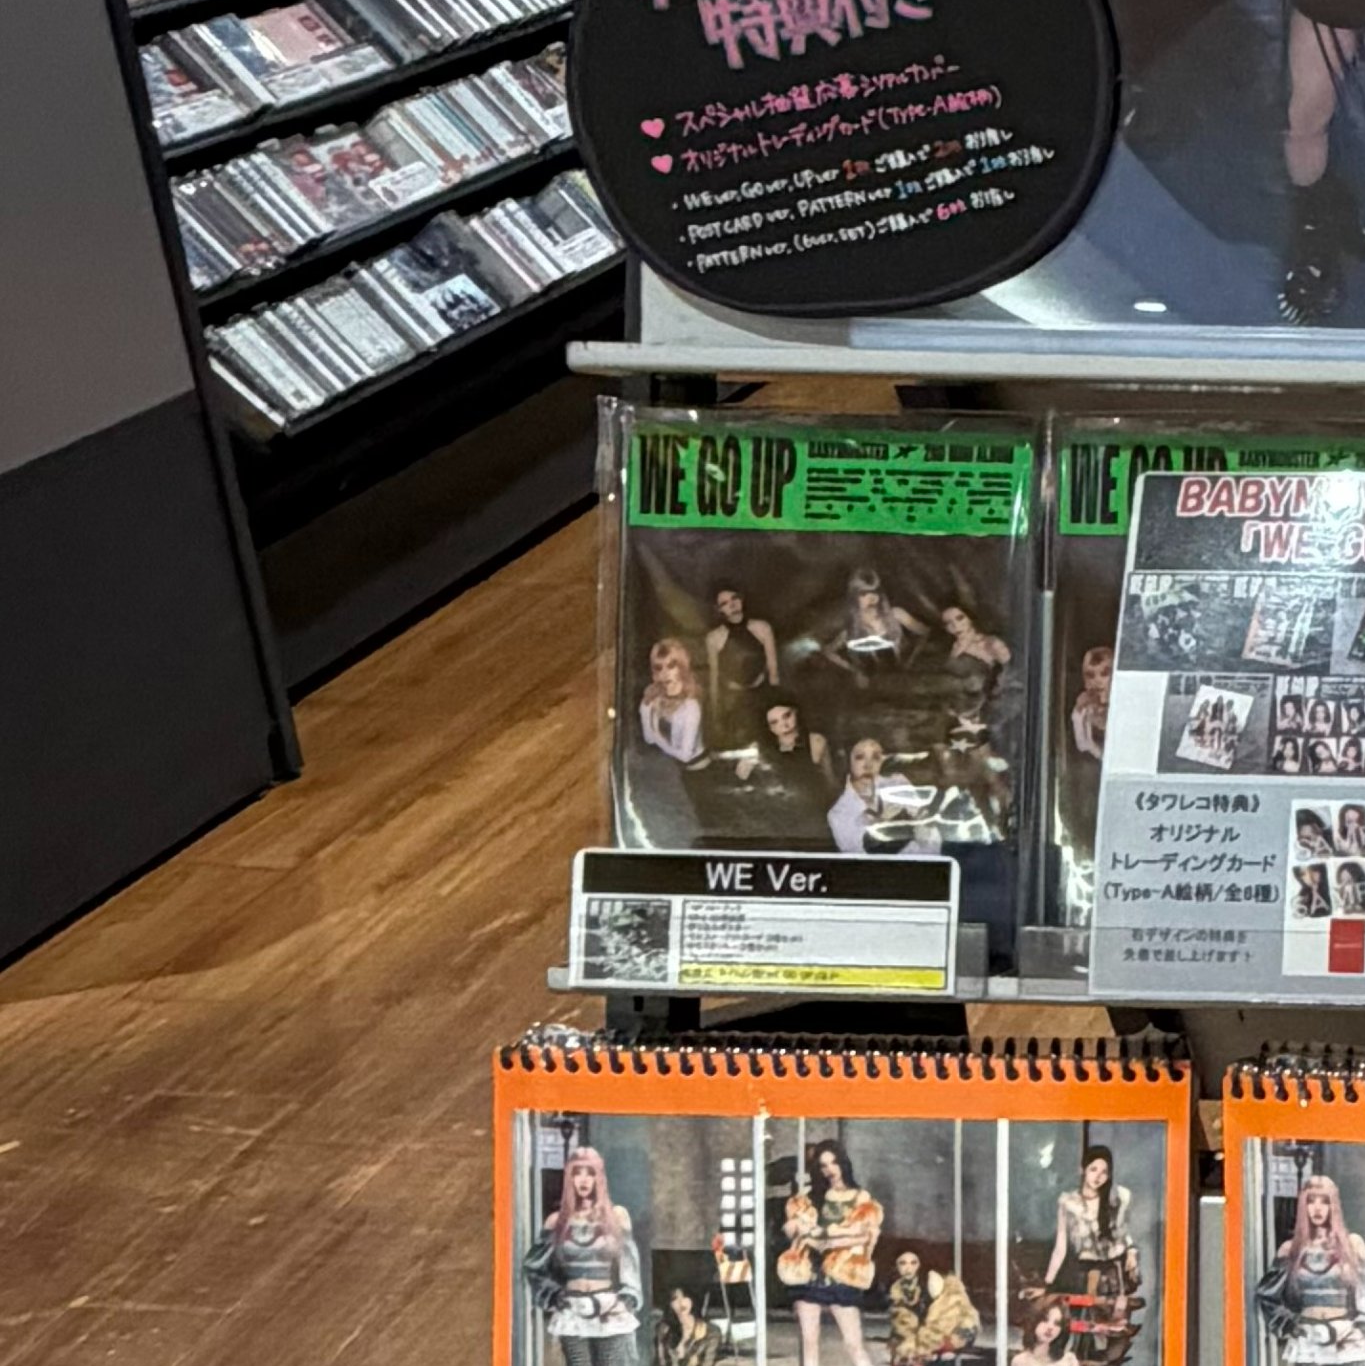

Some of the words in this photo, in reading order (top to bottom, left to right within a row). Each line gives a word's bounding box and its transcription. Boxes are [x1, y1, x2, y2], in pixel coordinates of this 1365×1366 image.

[639, 434, 687, 515] WE
[697, 434, 743, 519] GO
[749, 435, 797, 519] UP
[1070, 443, 1121, 525] WE
[1149, 825, 1241, 843] オリジナル
[705, 862, 754, 892] WE
[765, 863, 830, 894] Ver.
[1110, 853, 1277, 873] トレーディングカード
